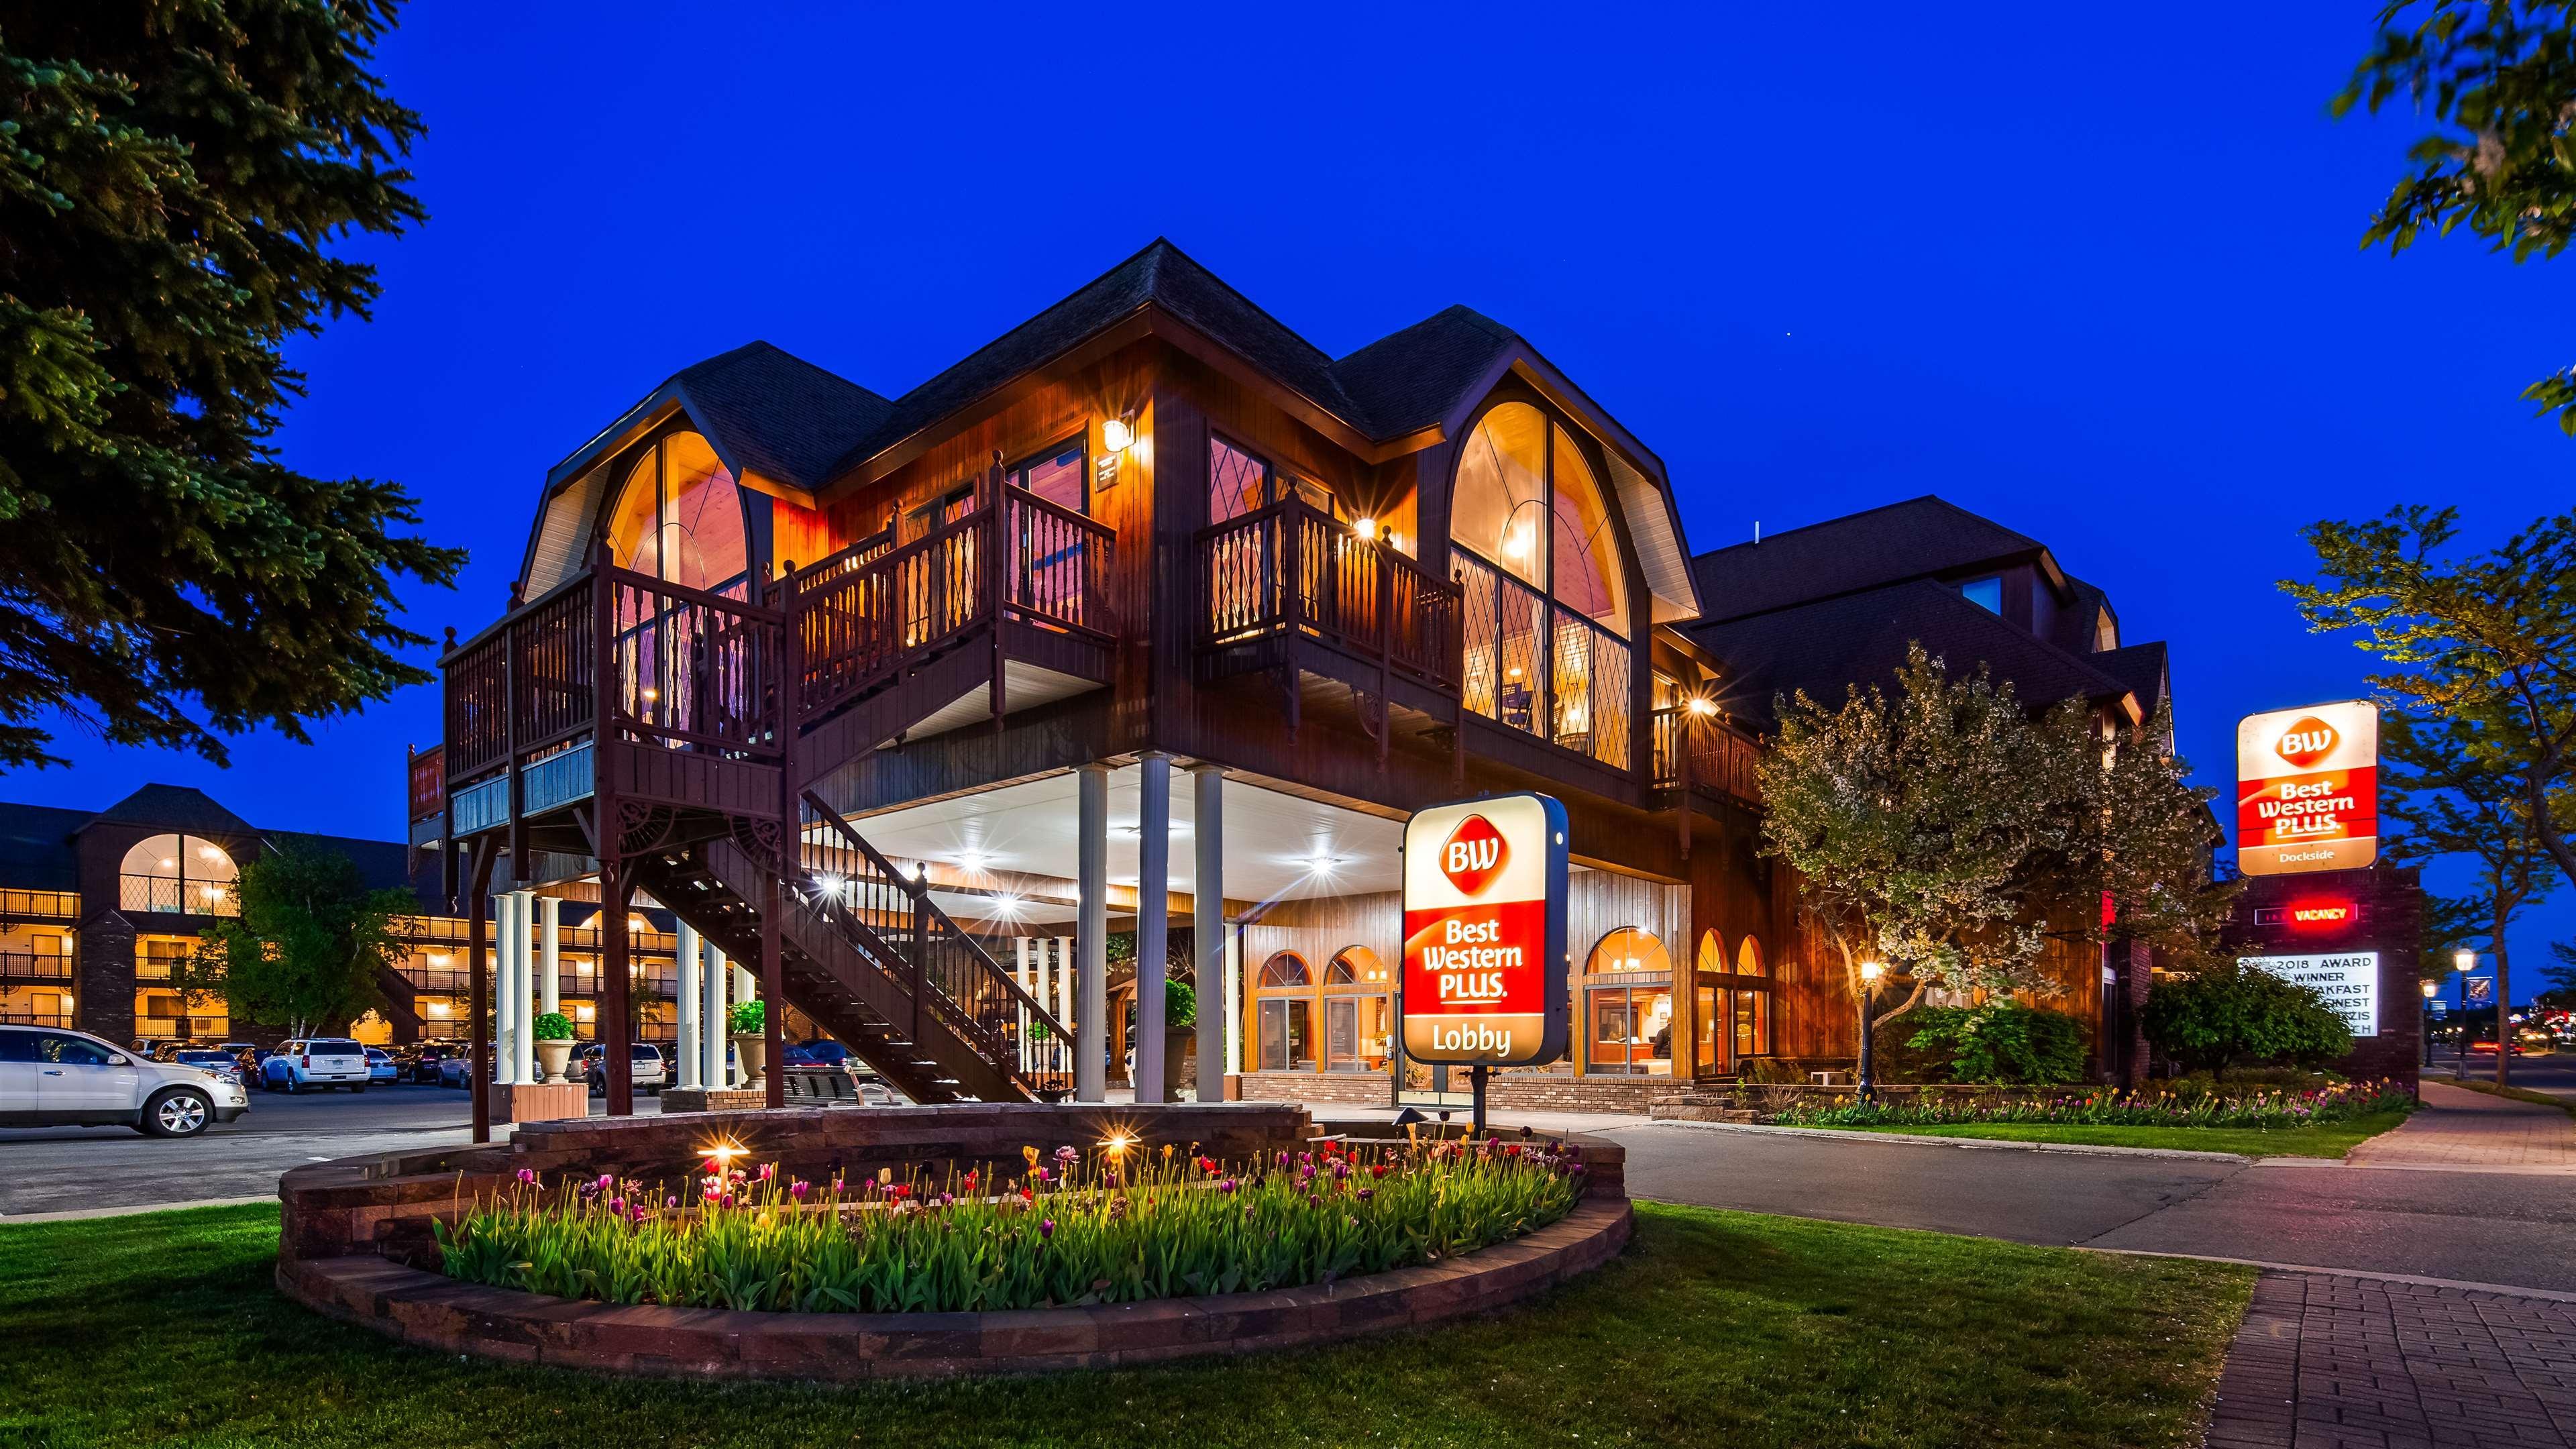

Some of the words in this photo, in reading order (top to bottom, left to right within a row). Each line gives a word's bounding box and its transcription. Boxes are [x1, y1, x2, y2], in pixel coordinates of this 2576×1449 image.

[2282, 729, 2332, 755] BW
[2280, 780, 2333, 800] Best
[2257, 796, 2355, 818] Western
[1448, 837, 1499, 873] BW
[2279, 849, 2335, 863] Dockside
[2294, 908, 2347, 922] VACANCY
[1446, 919, 1500, 945] Best
[1423, 947, 1523, 971] Western
[2277, 960, 2310, 970] 2018
[2320, 957, 2371, 969] AWARD
[2294, 972, 2345, 982] WINNER
[2308, 984, 2370, 995] AKFAST
[1432, 1023, 1511, 1058] Lobby
